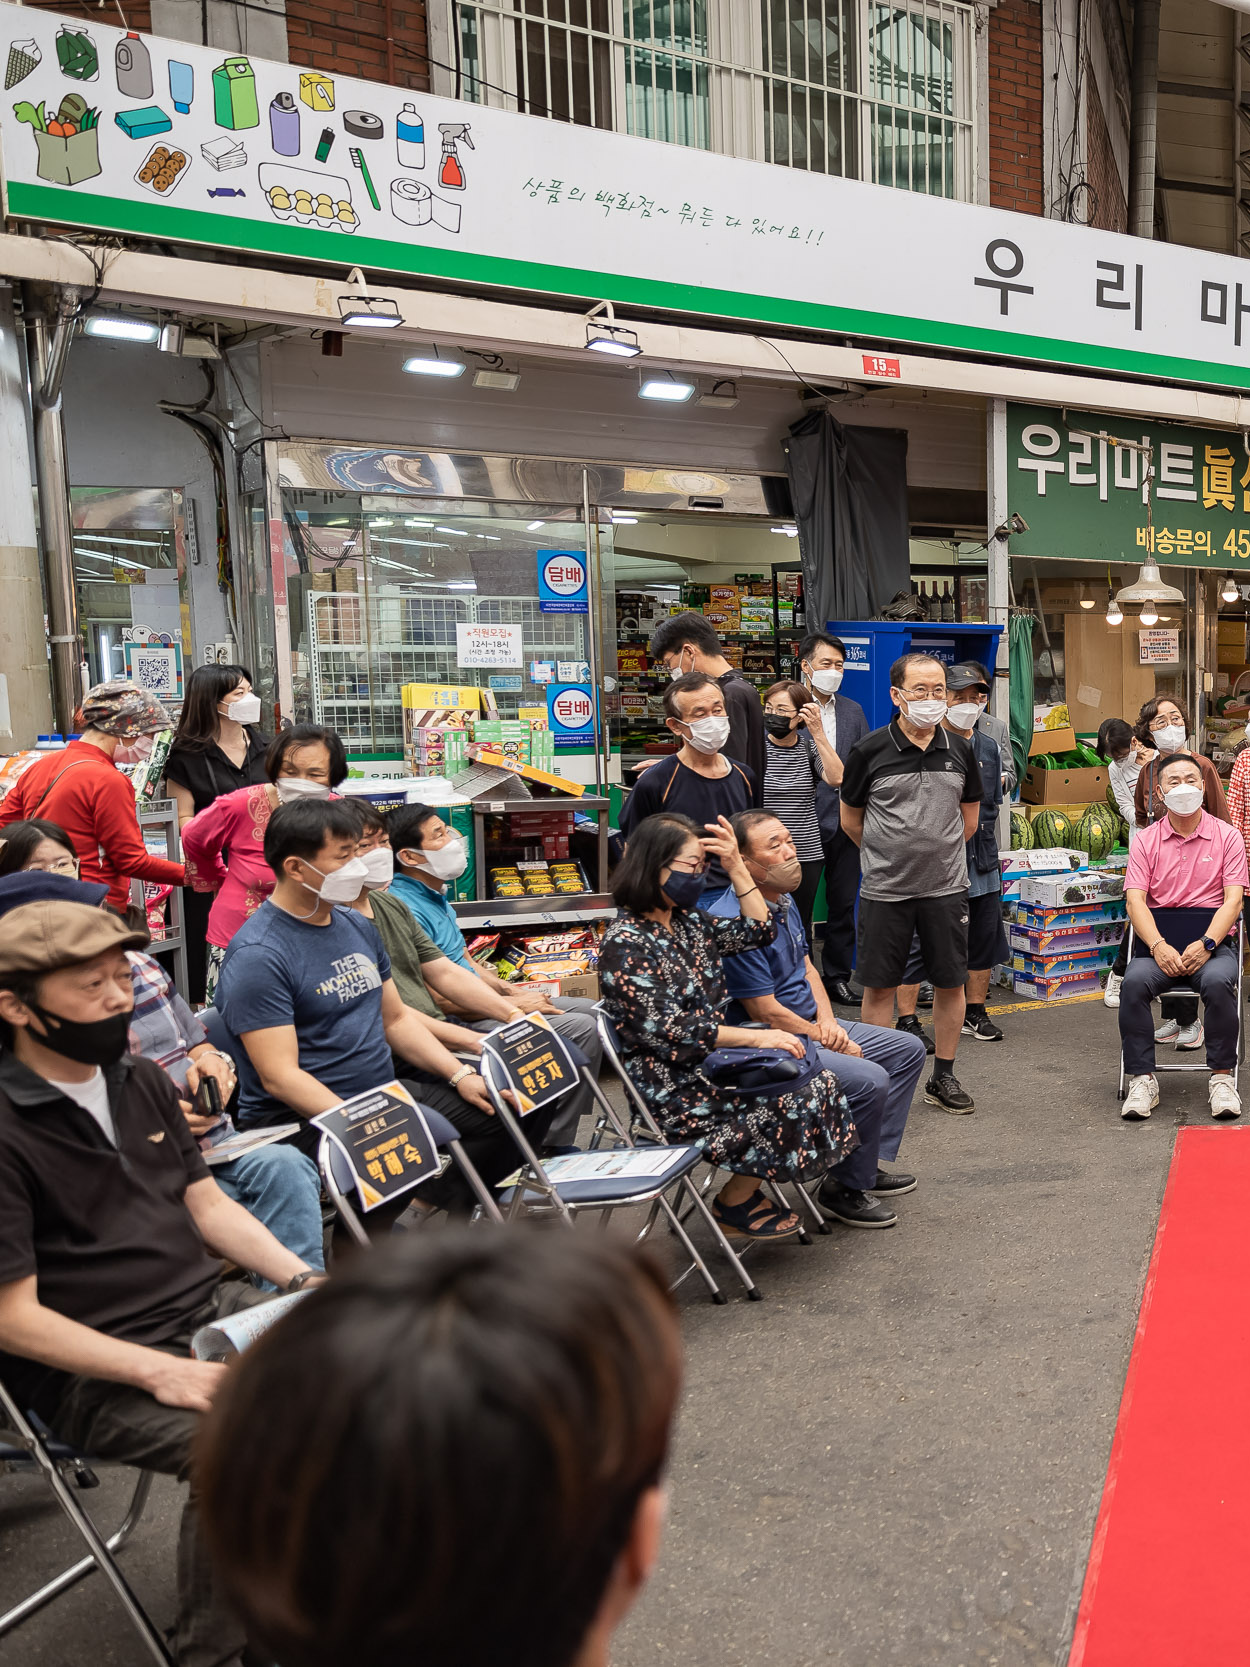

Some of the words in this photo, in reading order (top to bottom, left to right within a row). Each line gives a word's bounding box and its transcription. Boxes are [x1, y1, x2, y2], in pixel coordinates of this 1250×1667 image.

[522, 177, 585, 204] 상품의
[678, 202, 714, 227] 뭐든
[725, 215, 741, 227] 다
[751, 218, 824, 246] 있어요!!
[872, 359, 886, 371] 15
[548, 567, 581, 582] 담배
[622, 659, 639, 667] ZEC
[744, 658, 764, 668] Binch
[557, 701, 589, 715] 담배
[331, 955, 358, 974] THE
[320, 969, 363, 995] NORTH
[338, 979, 368, 1003] FACE
